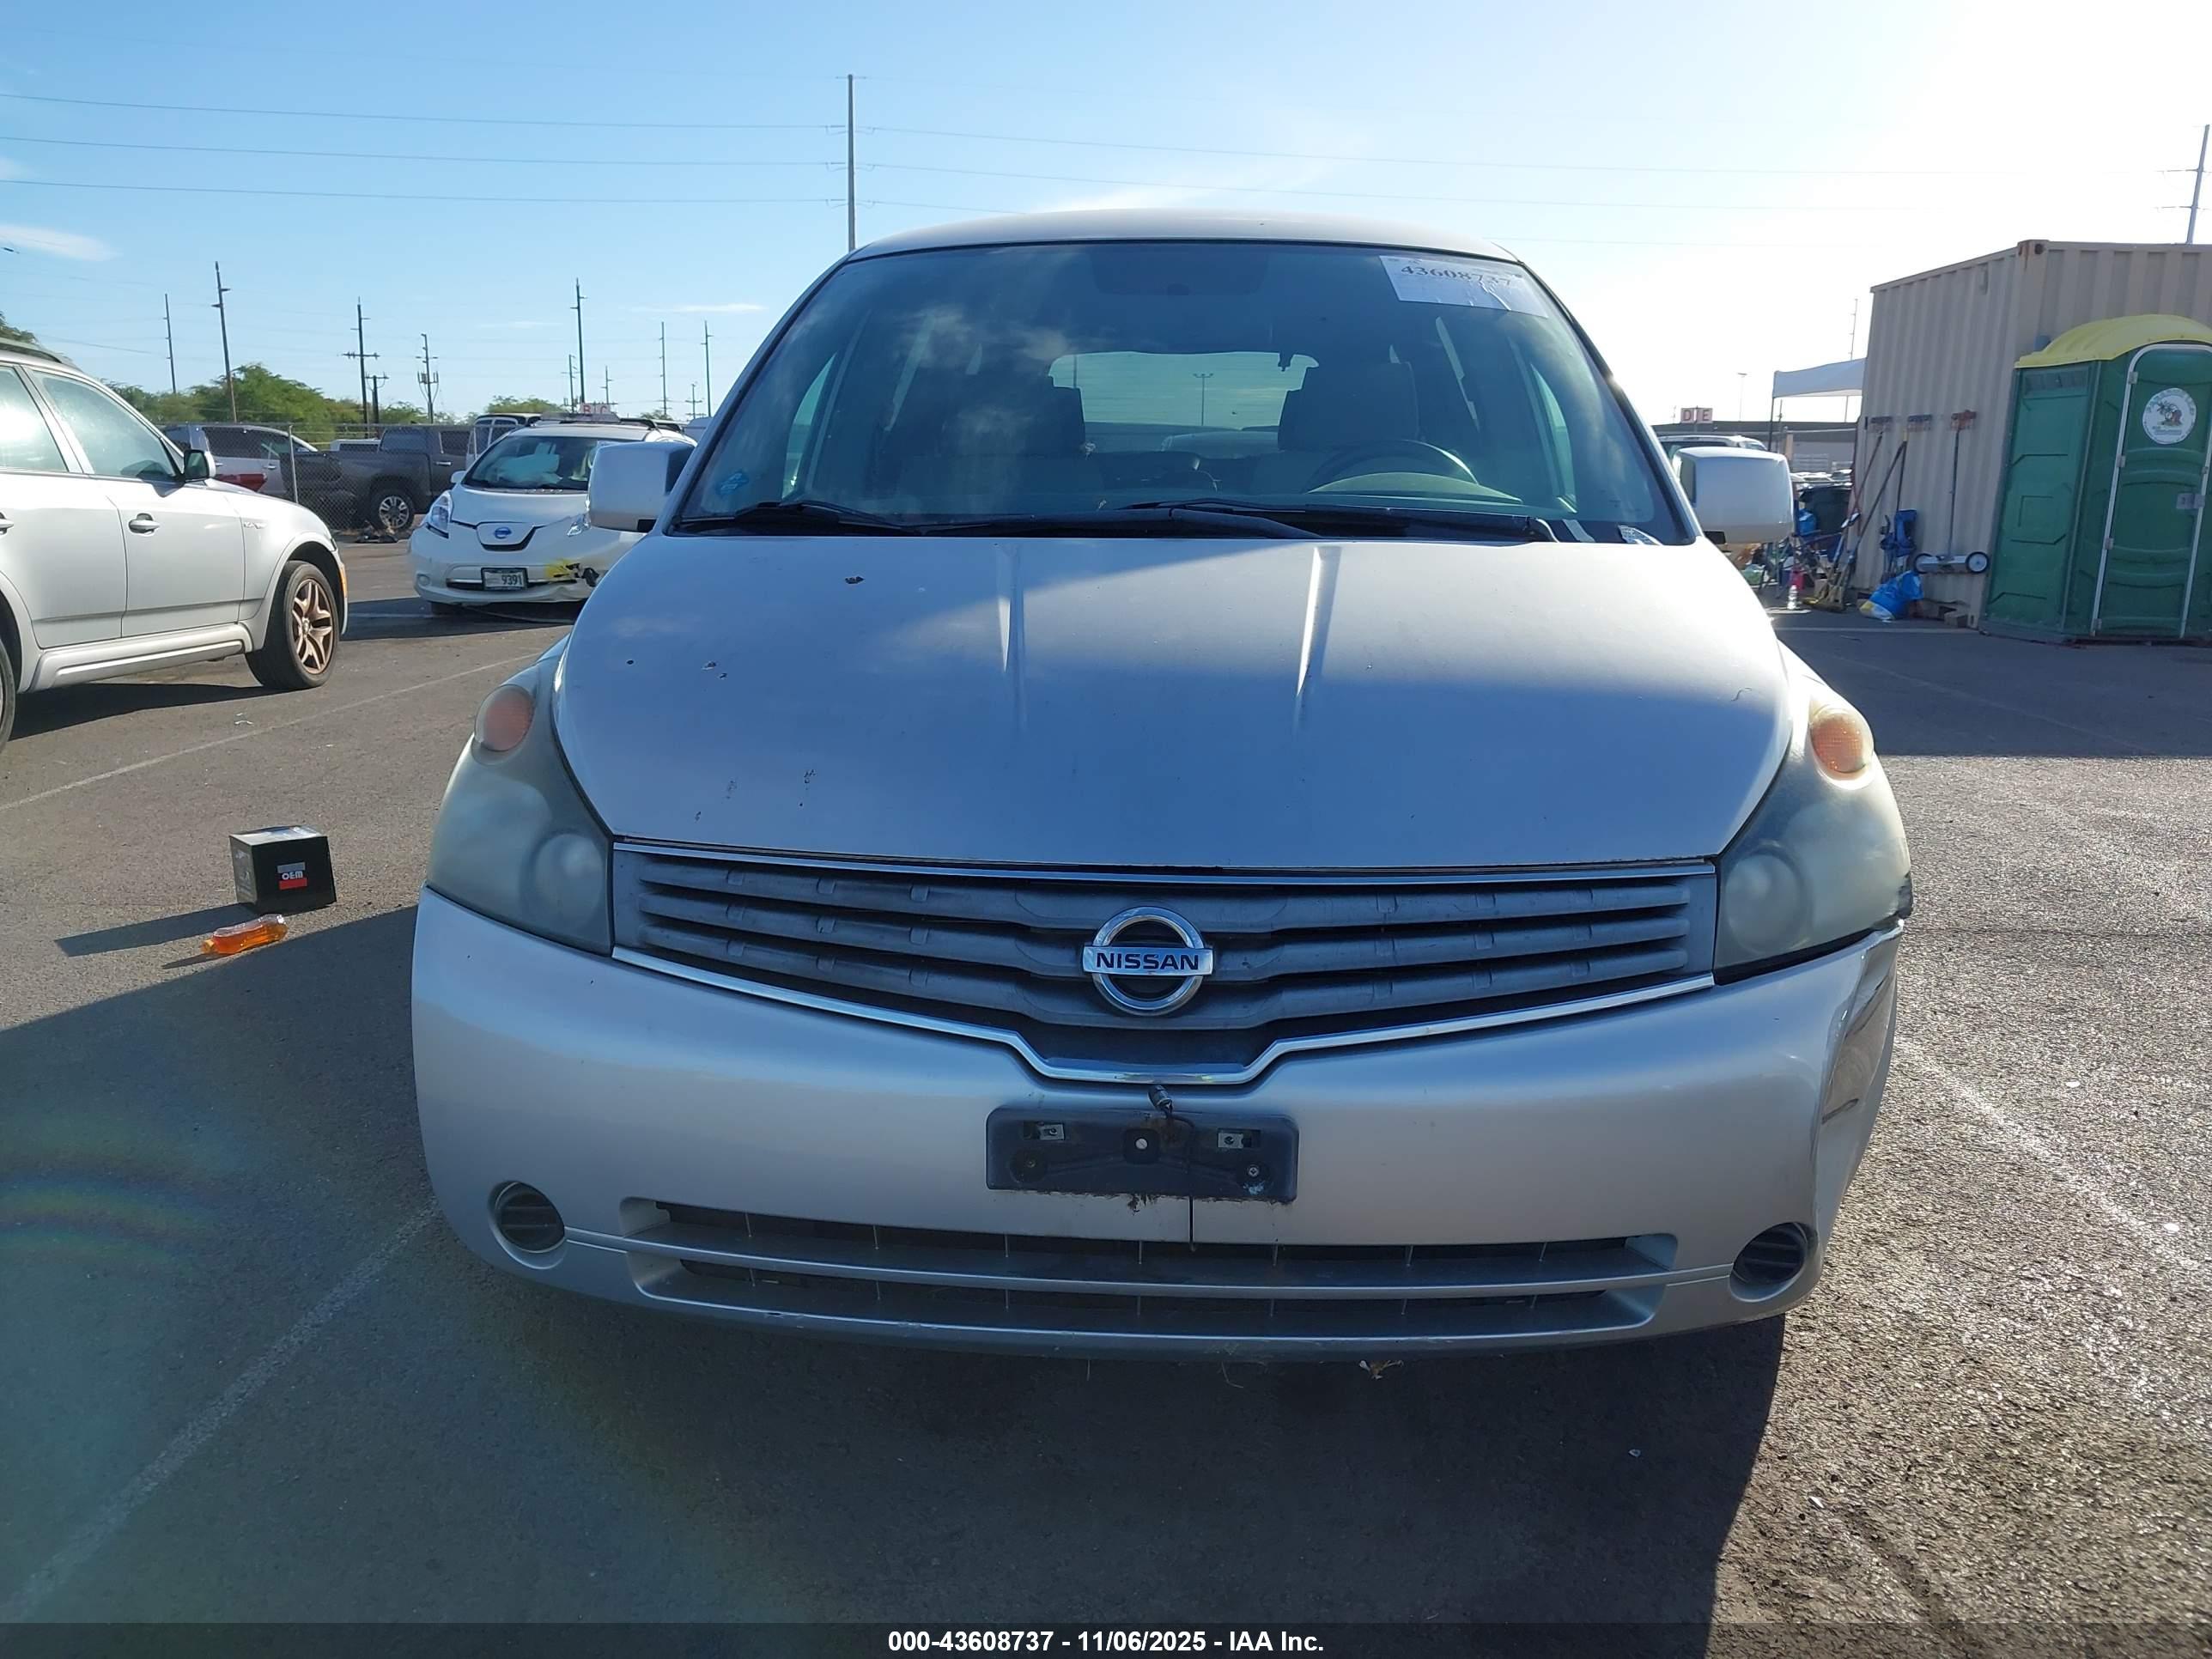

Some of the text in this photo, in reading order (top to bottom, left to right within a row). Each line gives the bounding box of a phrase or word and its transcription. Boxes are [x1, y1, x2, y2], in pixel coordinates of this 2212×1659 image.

[1401, 264, 1511, 286] 43608737
[1682, 409, 1692, 422] D
[1701, 409, 1710, 422] E
[501, 574, 523, 586] 9391
[281, 870, 304, 880] OEM
[1096, 952, 1199, 970] NISSAN
